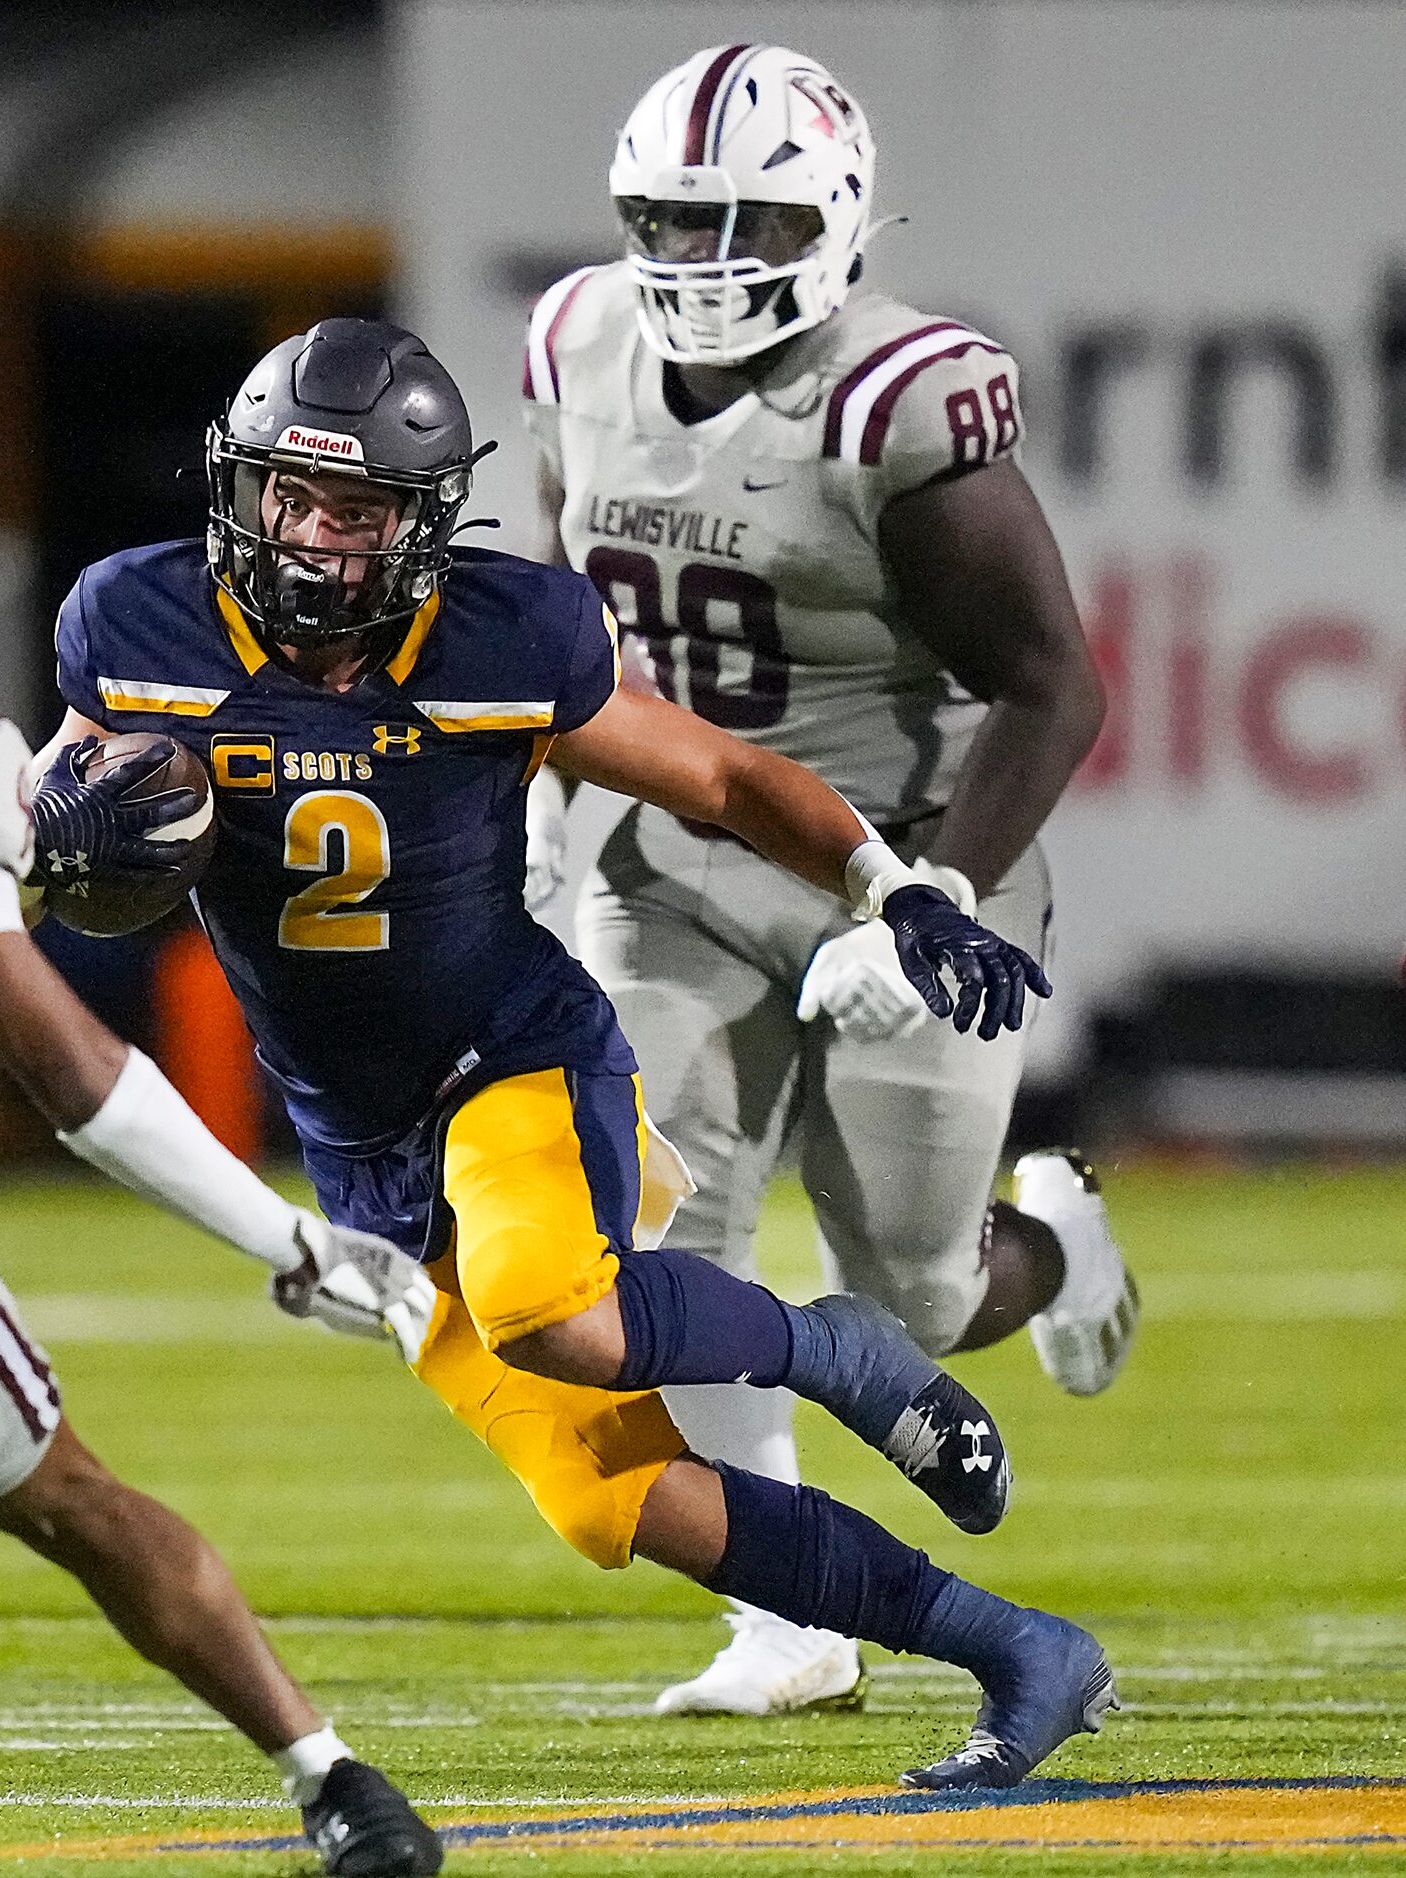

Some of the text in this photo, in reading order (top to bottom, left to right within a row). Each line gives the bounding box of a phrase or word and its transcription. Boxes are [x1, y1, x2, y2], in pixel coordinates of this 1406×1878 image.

[288, 430, 353, 455] Riddell
[946, 373, 1018, 463] 88
[588, 496, 748, 559] LEWISVILLE
[213, 744, 272, 788] C
[282, 752, 372, 781] SCOTS
[278, 789, 391, 951] 2
